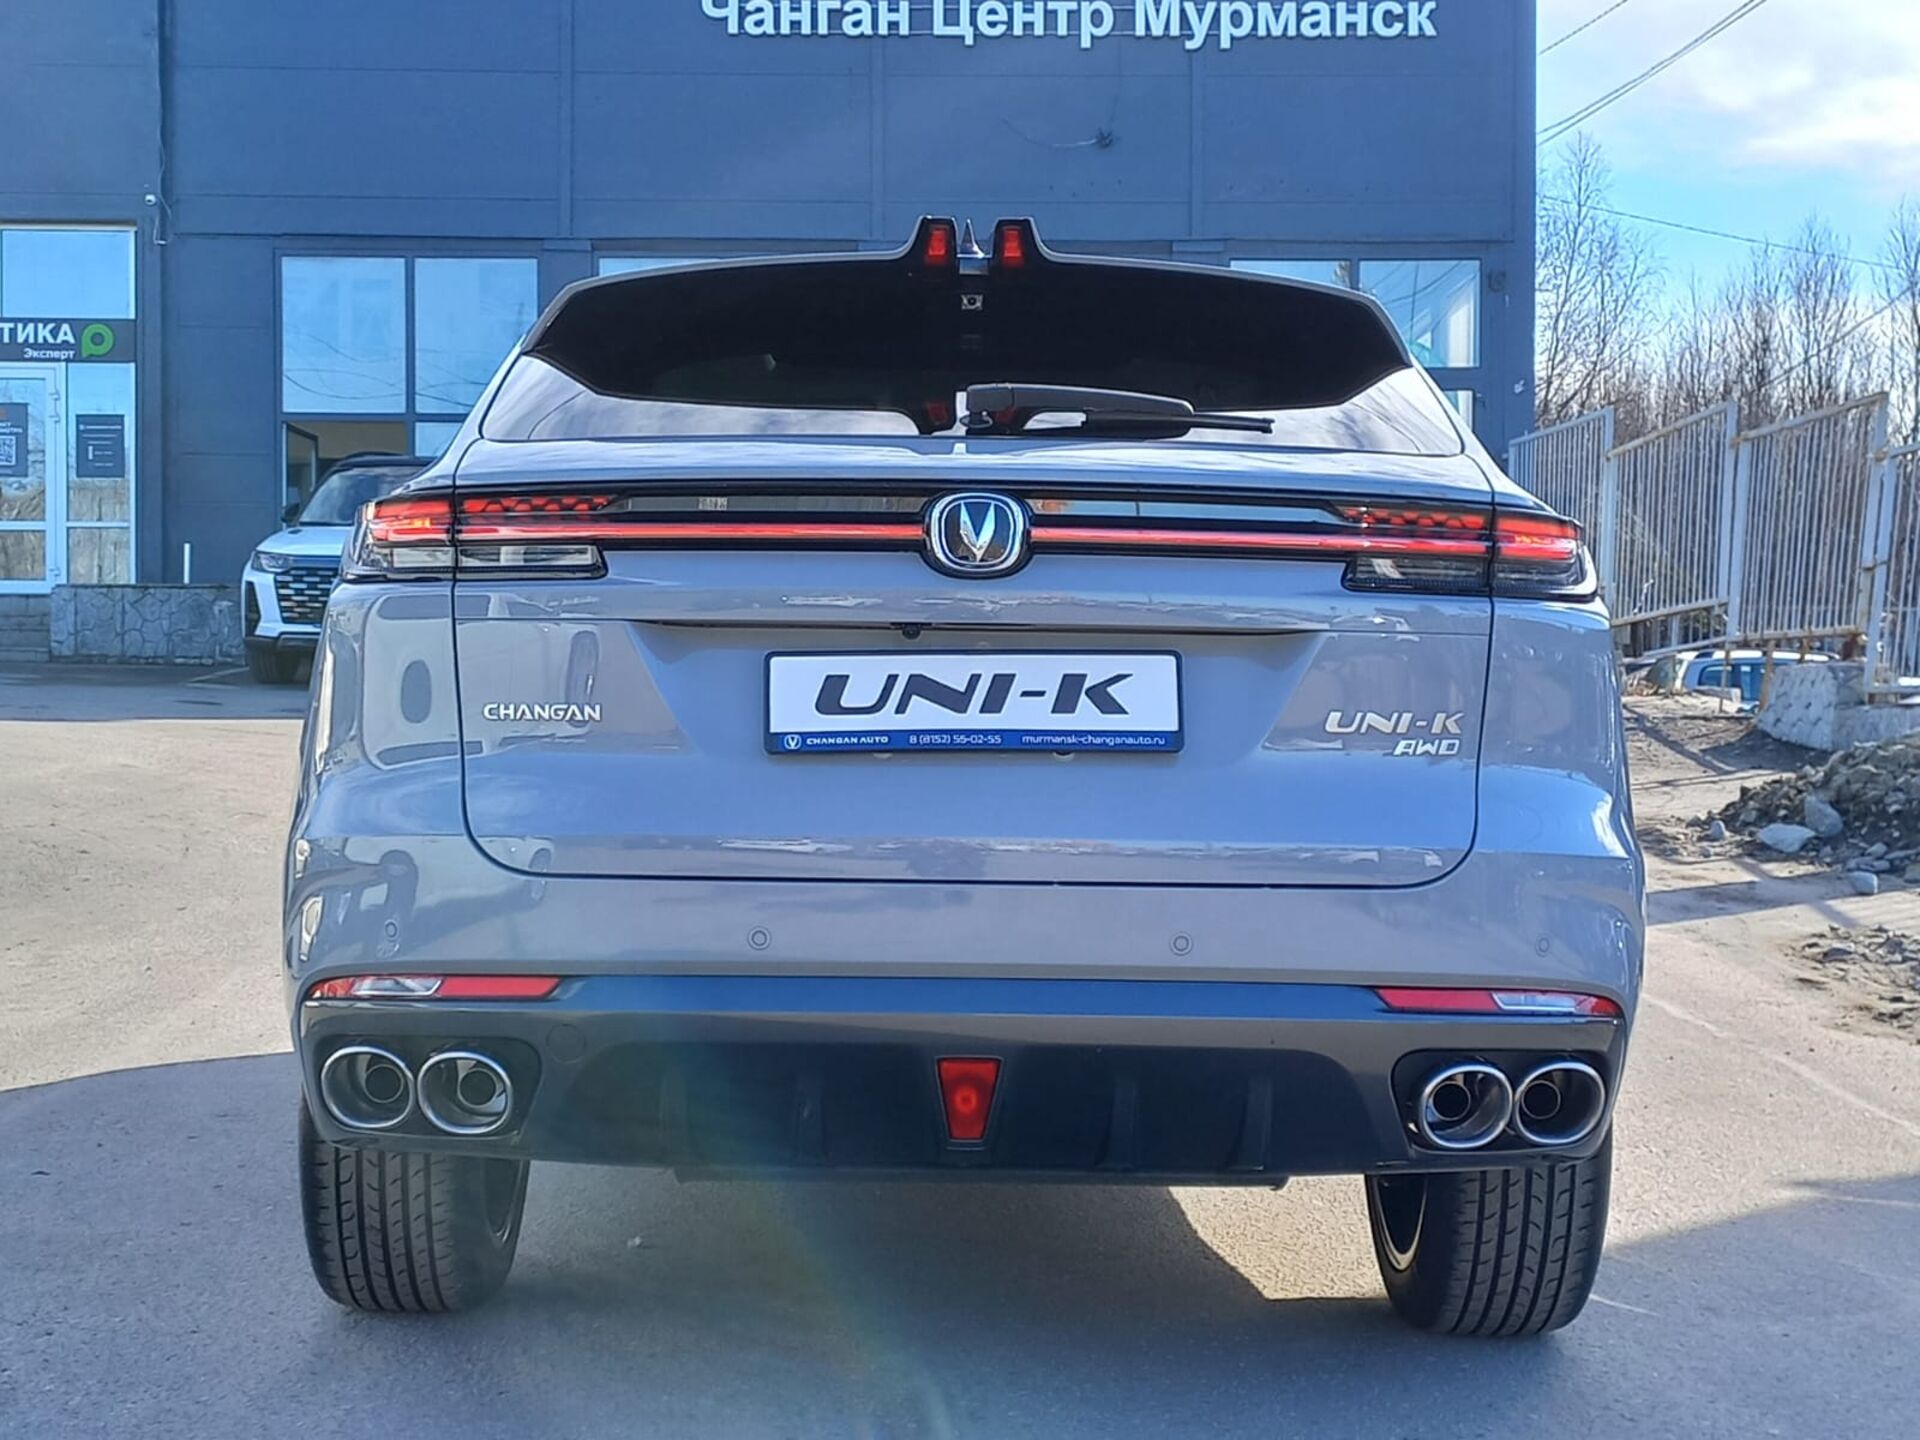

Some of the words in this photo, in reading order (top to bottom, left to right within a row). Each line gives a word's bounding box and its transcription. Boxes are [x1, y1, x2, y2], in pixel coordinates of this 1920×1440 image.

[701, 0, 910, 36] Чанган
[933, 0, 1114, 48] Центр
[1135, 0, 1437, 49] Мурманск
[0, 322, 76, 344] ТИКА
[23, 348, 75, 360] Эксперт
[814, 673, 1133, 715] UNI-K
[483, 703, 601, 721] CHANGAN
[1325, 711, 1465, 734] UNI-K
[806, 736, 858, 745] CHANGAN
[859, 736, 889, 745] AUTO
[909, 734, 918, 744] 8
[919, 734, 951, 745] (8152)
[953, 734, 1002, 744] 55-02-55
[1021, 734, 1166, 746] murmansk-changanauto.ru
[1393, 739, 1460, 756] AWD
